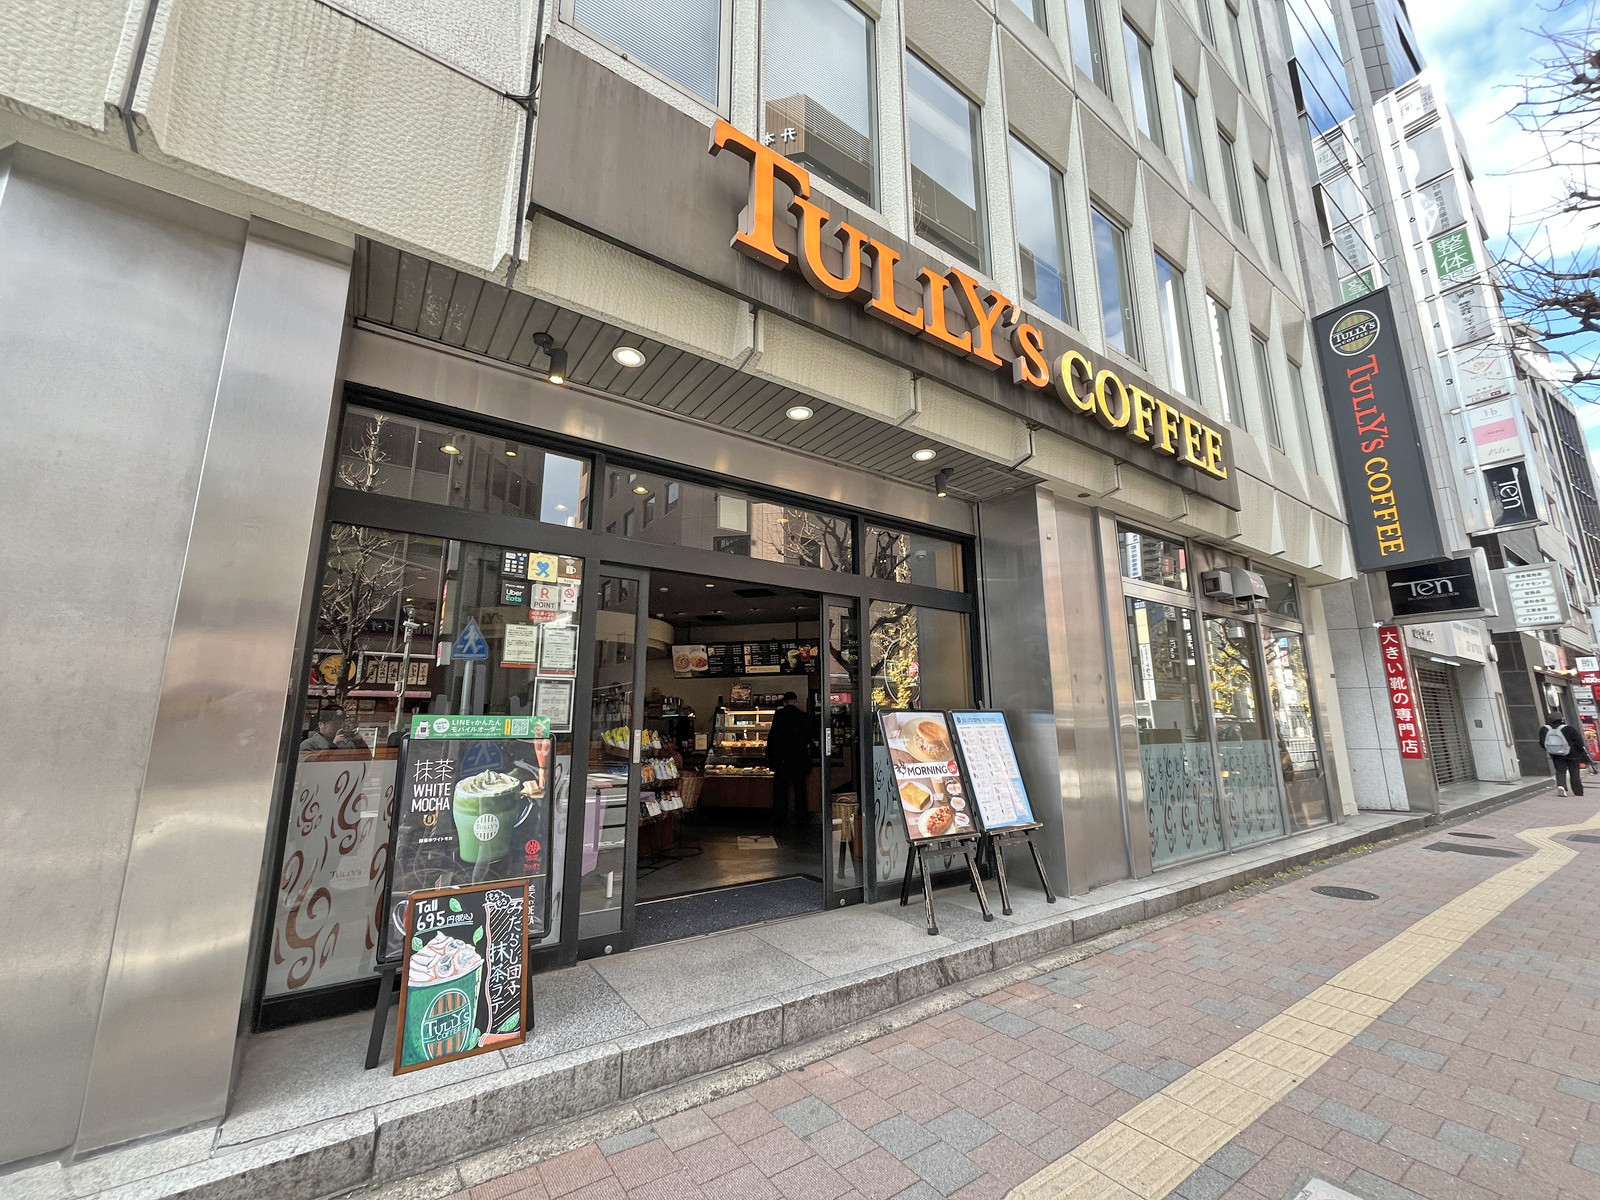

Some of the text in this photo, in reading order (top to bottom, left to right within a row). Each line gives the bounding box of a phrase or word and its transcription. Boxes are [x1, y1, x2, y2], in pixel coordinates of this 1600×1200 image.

[1436, 233, 1469, 273] 整体
[709, 118, 1229, 481] TULLY'S COFFEE
[1332, 321, 1376, 343] TULLY'S
[1342, 331, 1368, 345] COFFEE
[1459, 436, 1468, 445] 2
[1347, 353, 1405, 557] TULLY'S COFFEE
[506, 588, 523, 596] Uber
[540, 587, 550, 599] R
[1396, 575, 1463, 597] Ten
[505, 594, 522, 602] Eats
[533, 601, 556, 609] POINT
[1381, 631, 1419, 755] 大きい靴の専門店
[413, 758, 455, 783] 抹茶
[907, 765, 948, 776] MORNING
[413, 783, 451, 798] WHITE
[411, 797, 451, 813] MOCHA
[415, 898, 439, 914] Tall
[507, 900, 523, 996] みたらし団子
[489, 940, 511, 1015] 抹茶ラテ
